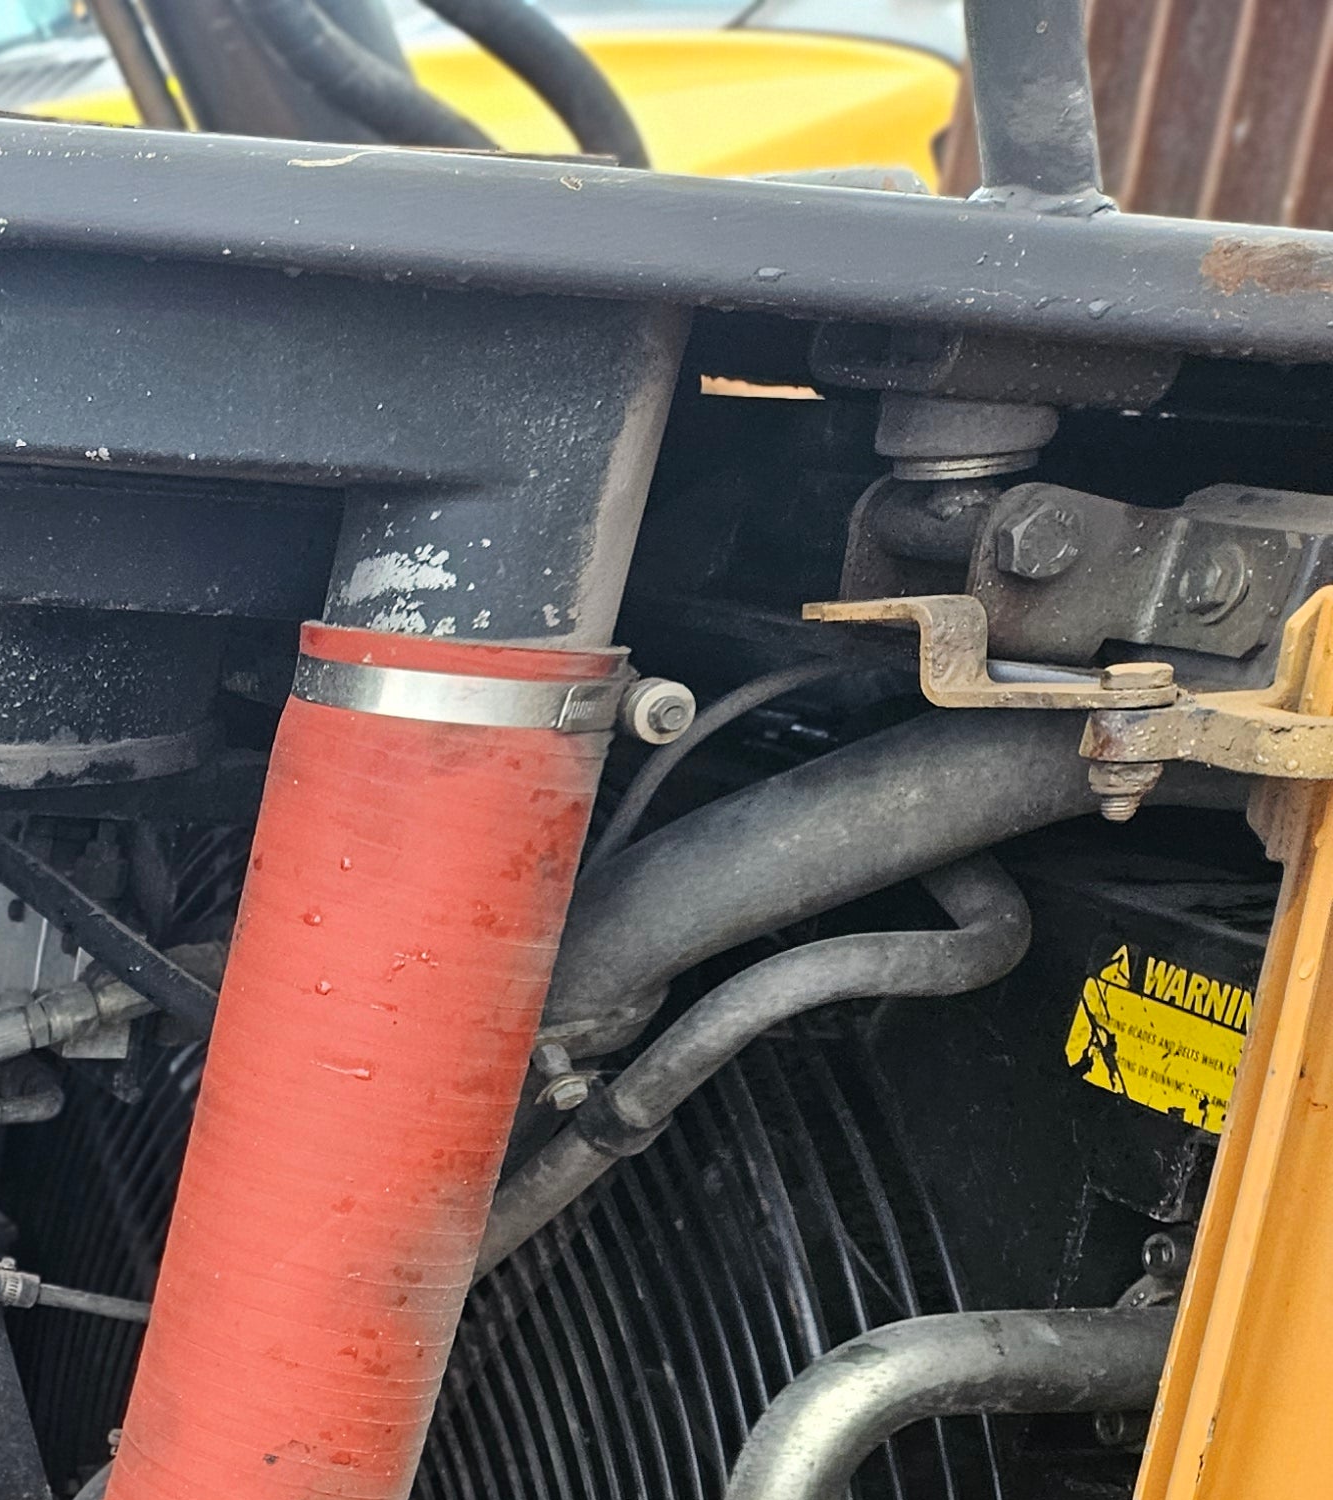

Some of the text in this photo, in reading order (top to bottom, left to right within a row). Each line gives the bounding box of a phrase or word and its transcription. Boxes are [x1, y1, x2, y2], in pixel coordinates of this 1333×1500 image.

[1143, 955, 1253, 1032] WARNIN
[1128, 1022, 1157, 1047] BLADES
[1201, 1052, 1224, 1073] WHEN
[1138, 1063, 1149, 1078] OR
